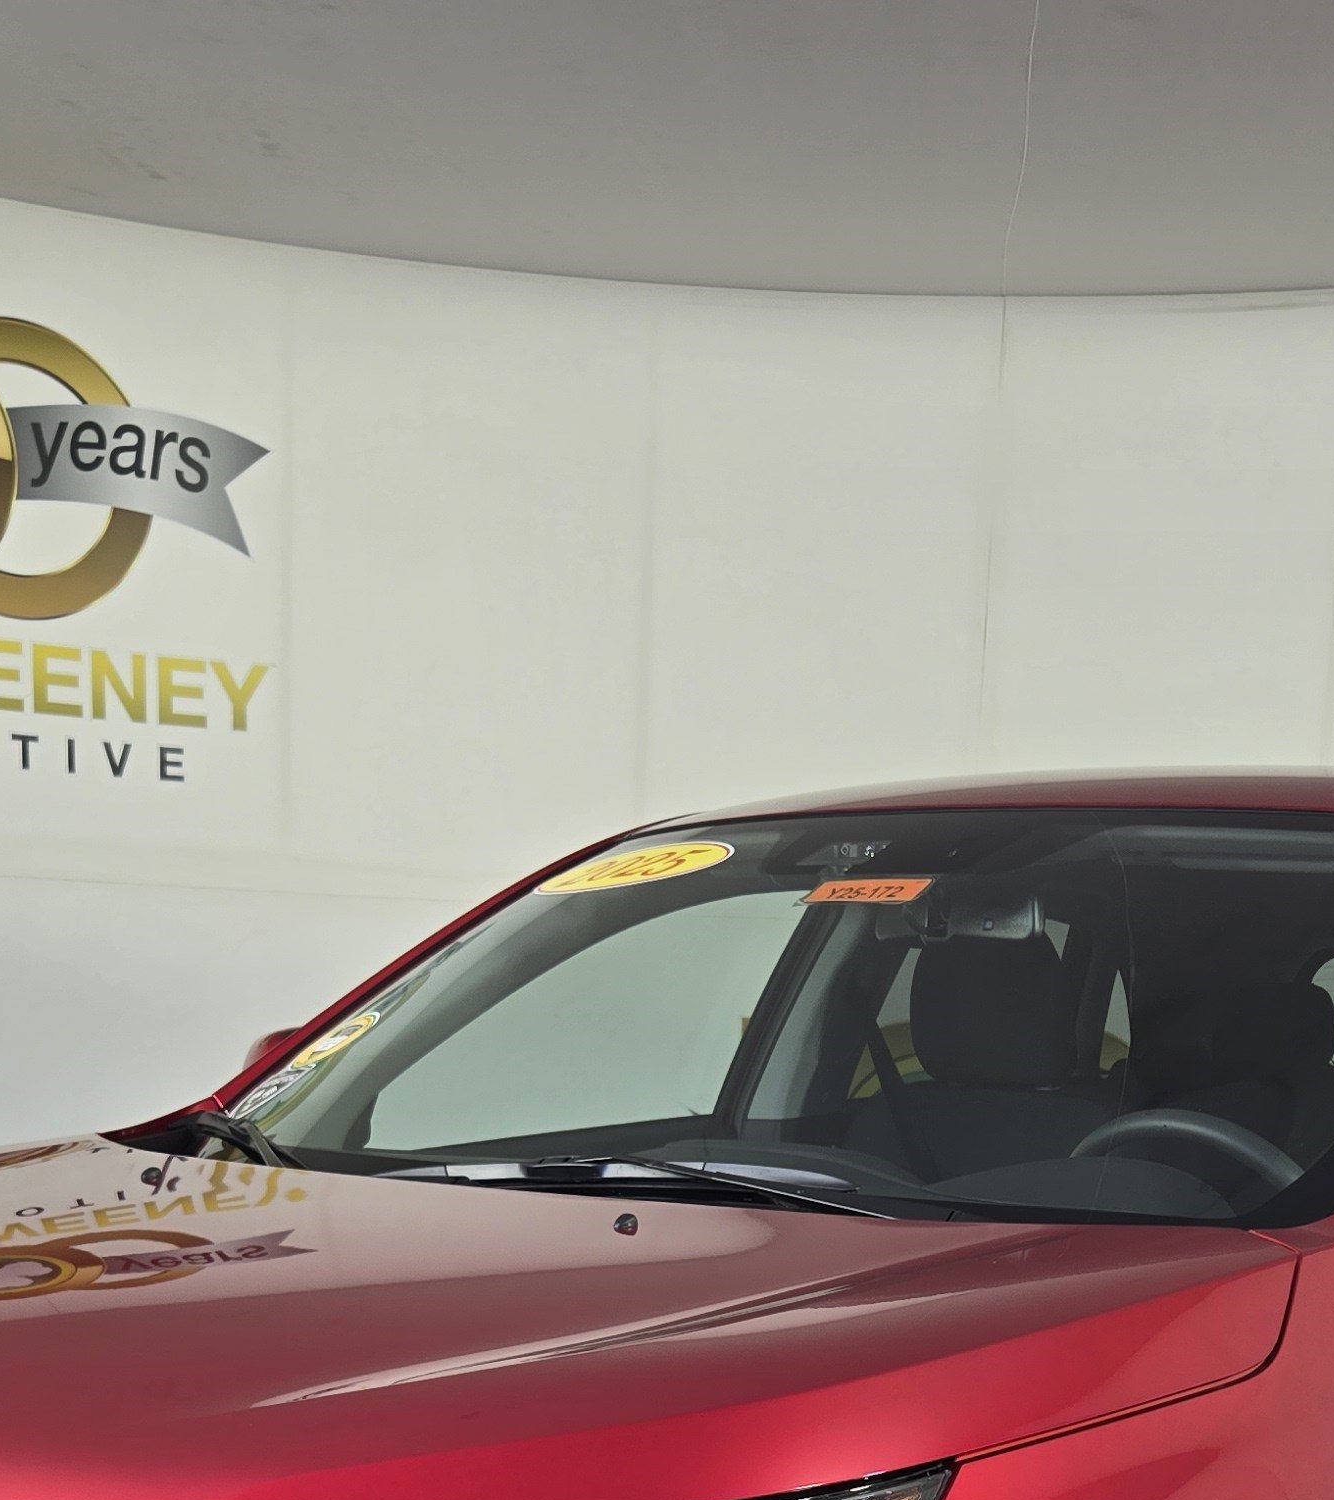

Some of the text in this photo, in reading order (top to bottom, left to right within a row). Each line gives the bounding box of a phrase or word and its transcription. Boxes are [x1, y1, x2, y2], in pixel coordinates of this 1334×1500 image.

[29, 418, 211, 494] years
[554, 848, 712, 888] 2025
[827, 885, 915, 900] Y25-172
